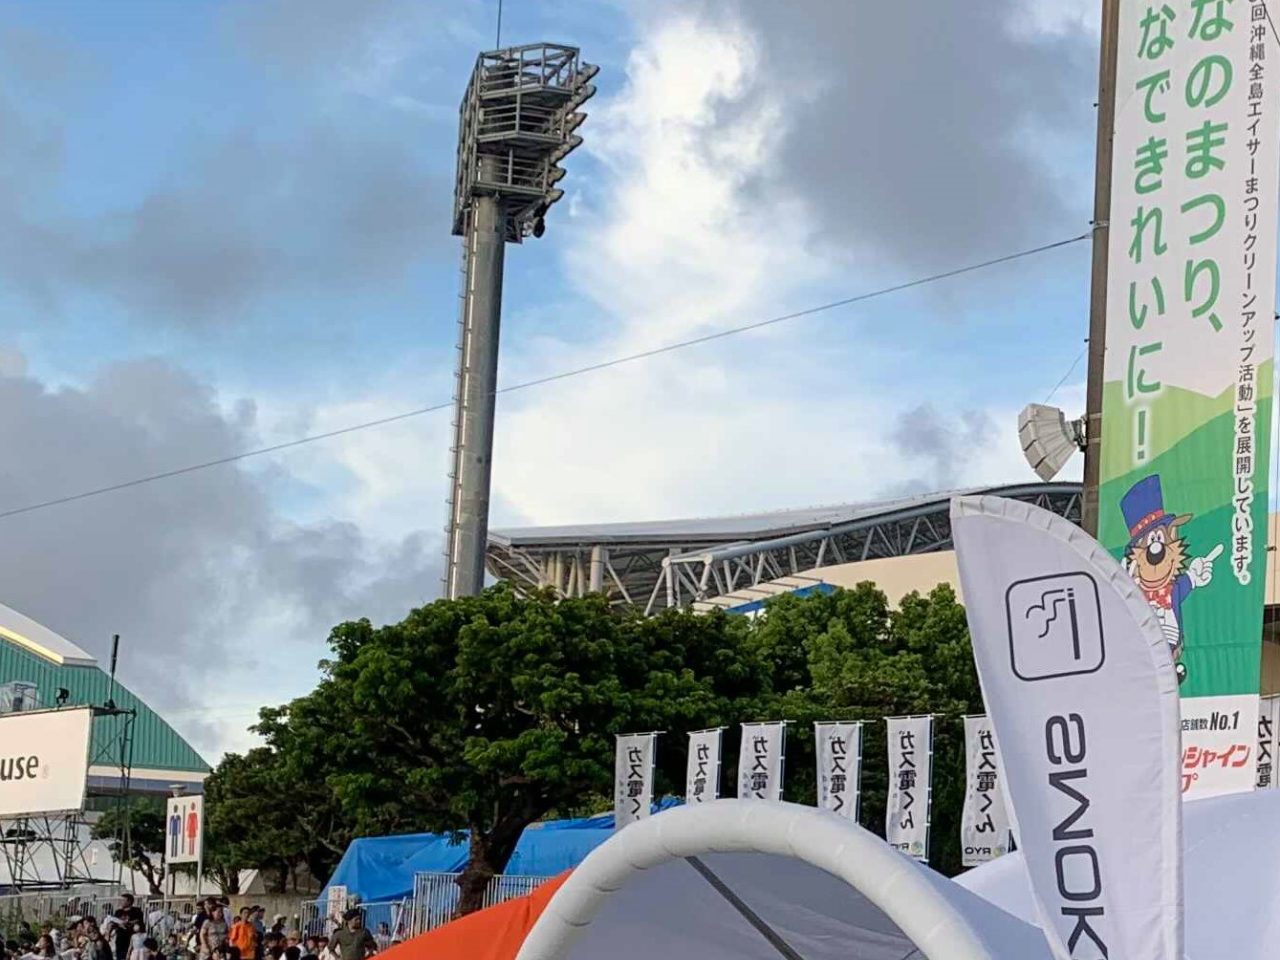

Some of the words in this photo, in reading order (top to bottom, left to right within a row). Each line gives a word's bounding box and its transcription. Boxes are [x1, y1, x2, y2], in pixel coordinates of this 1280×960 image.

[1209, 711, 1239, 731] No.1
[1182, 744, 1251, 769] シャイン
